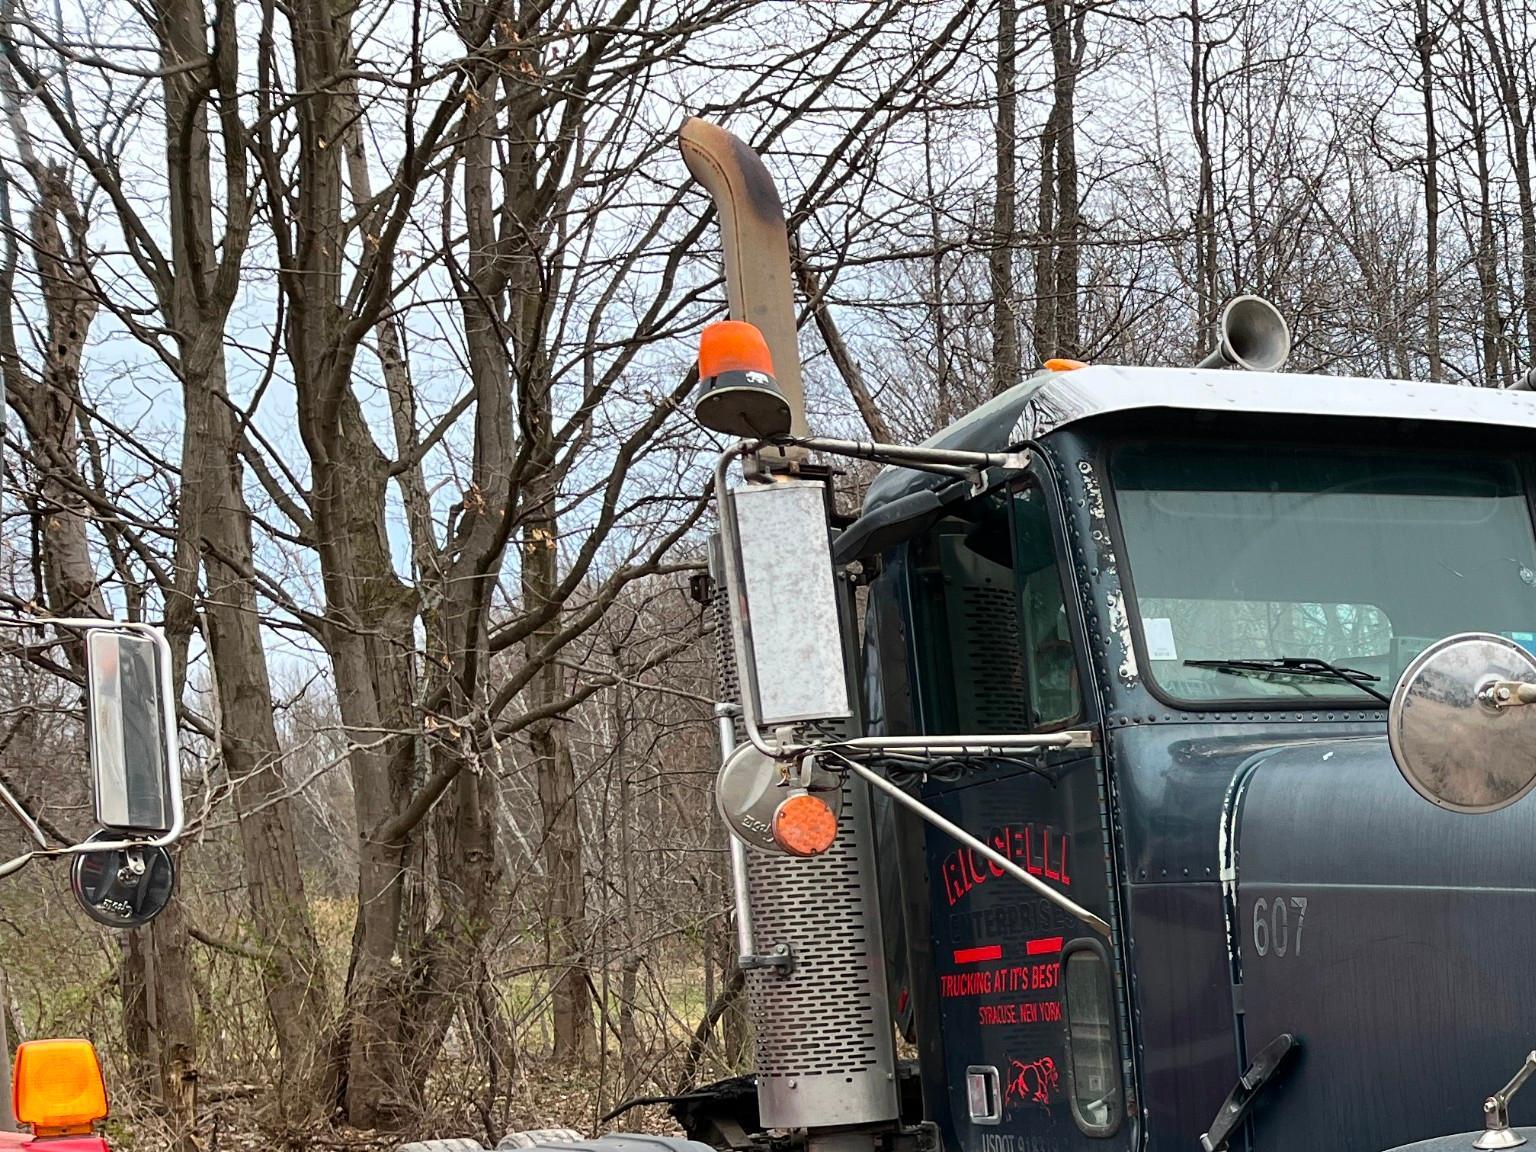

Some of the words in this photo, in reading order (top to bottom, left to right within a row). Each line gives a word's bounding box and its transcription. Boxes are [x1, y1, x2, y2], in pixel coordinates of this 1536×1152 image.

[1252, 896, 1308, 958] 607
[940, 971, 992, 997] TRUCKING
[993, 969, 1009, 993] AT
[1009, 967, 1029, 991] IT'S
[1031, 962, 1061, 989] BEST
[1020, 1003, 1038, 1024] NEW
[1038, 1001, 1062, 1023] YORK
